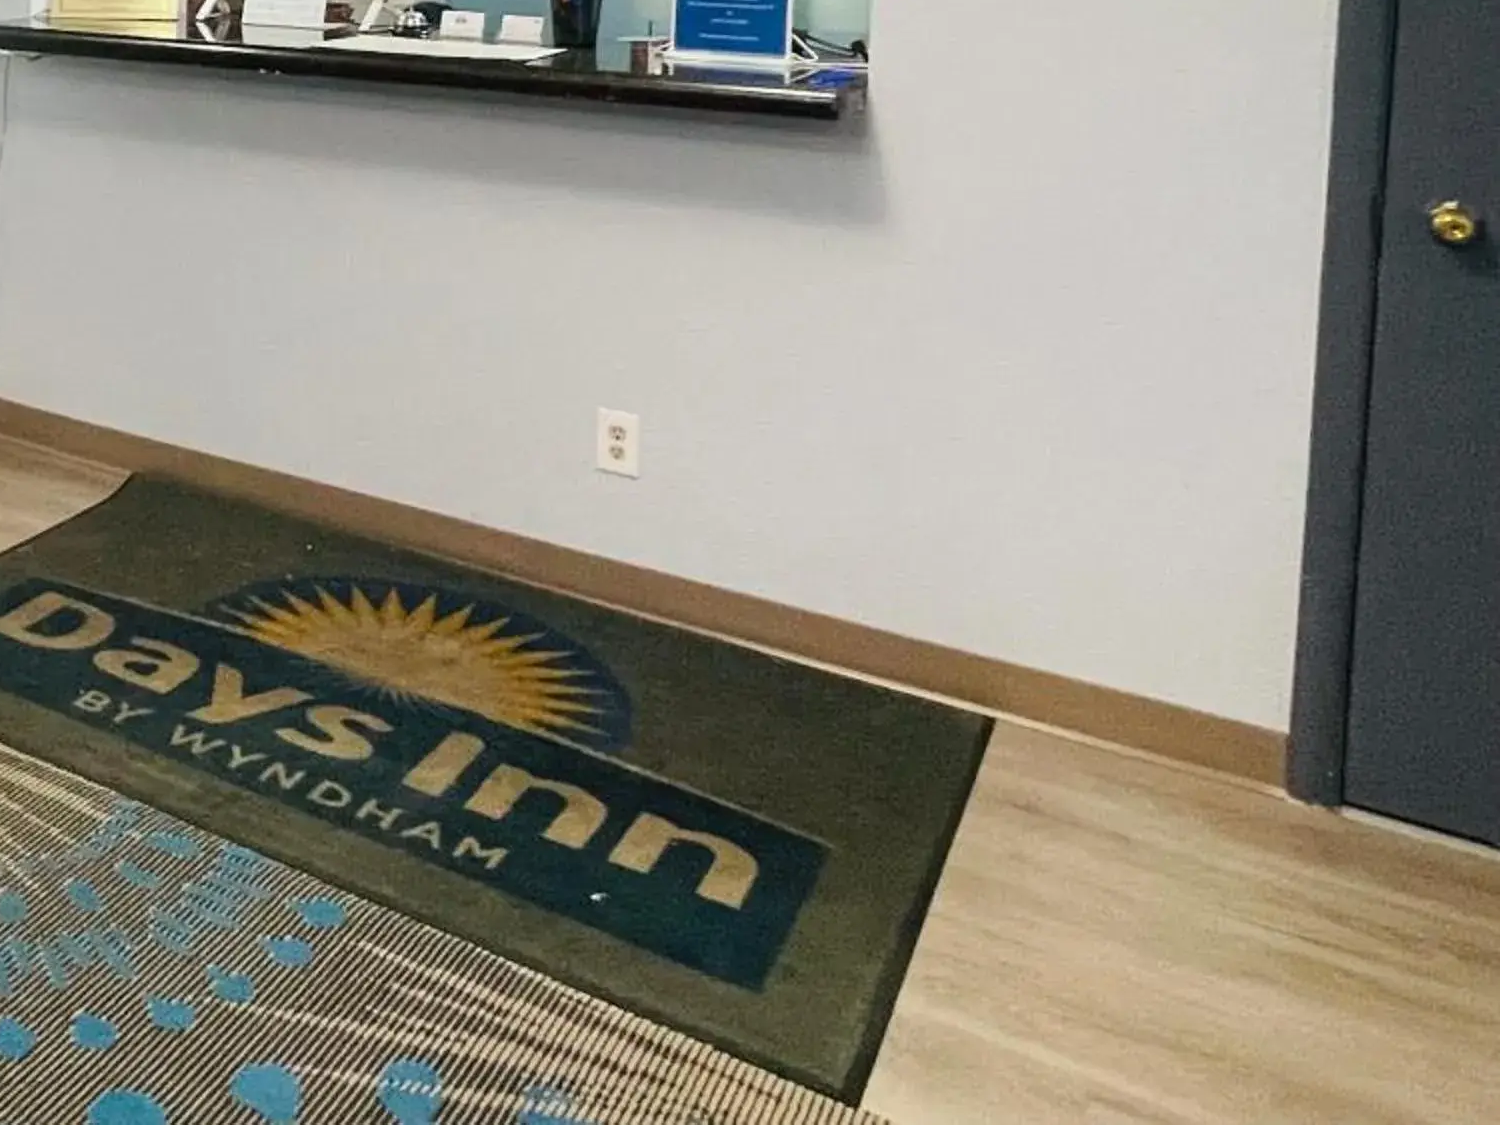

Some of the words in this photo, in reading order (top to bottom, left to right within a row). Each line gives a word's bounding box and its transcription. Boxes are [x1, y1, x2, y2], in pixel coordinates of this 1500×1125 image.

[71, 687, 157, 730] BY
[167, 723, 508, 873] WYNDHAM
[401, 729, 761, 913] Inn
